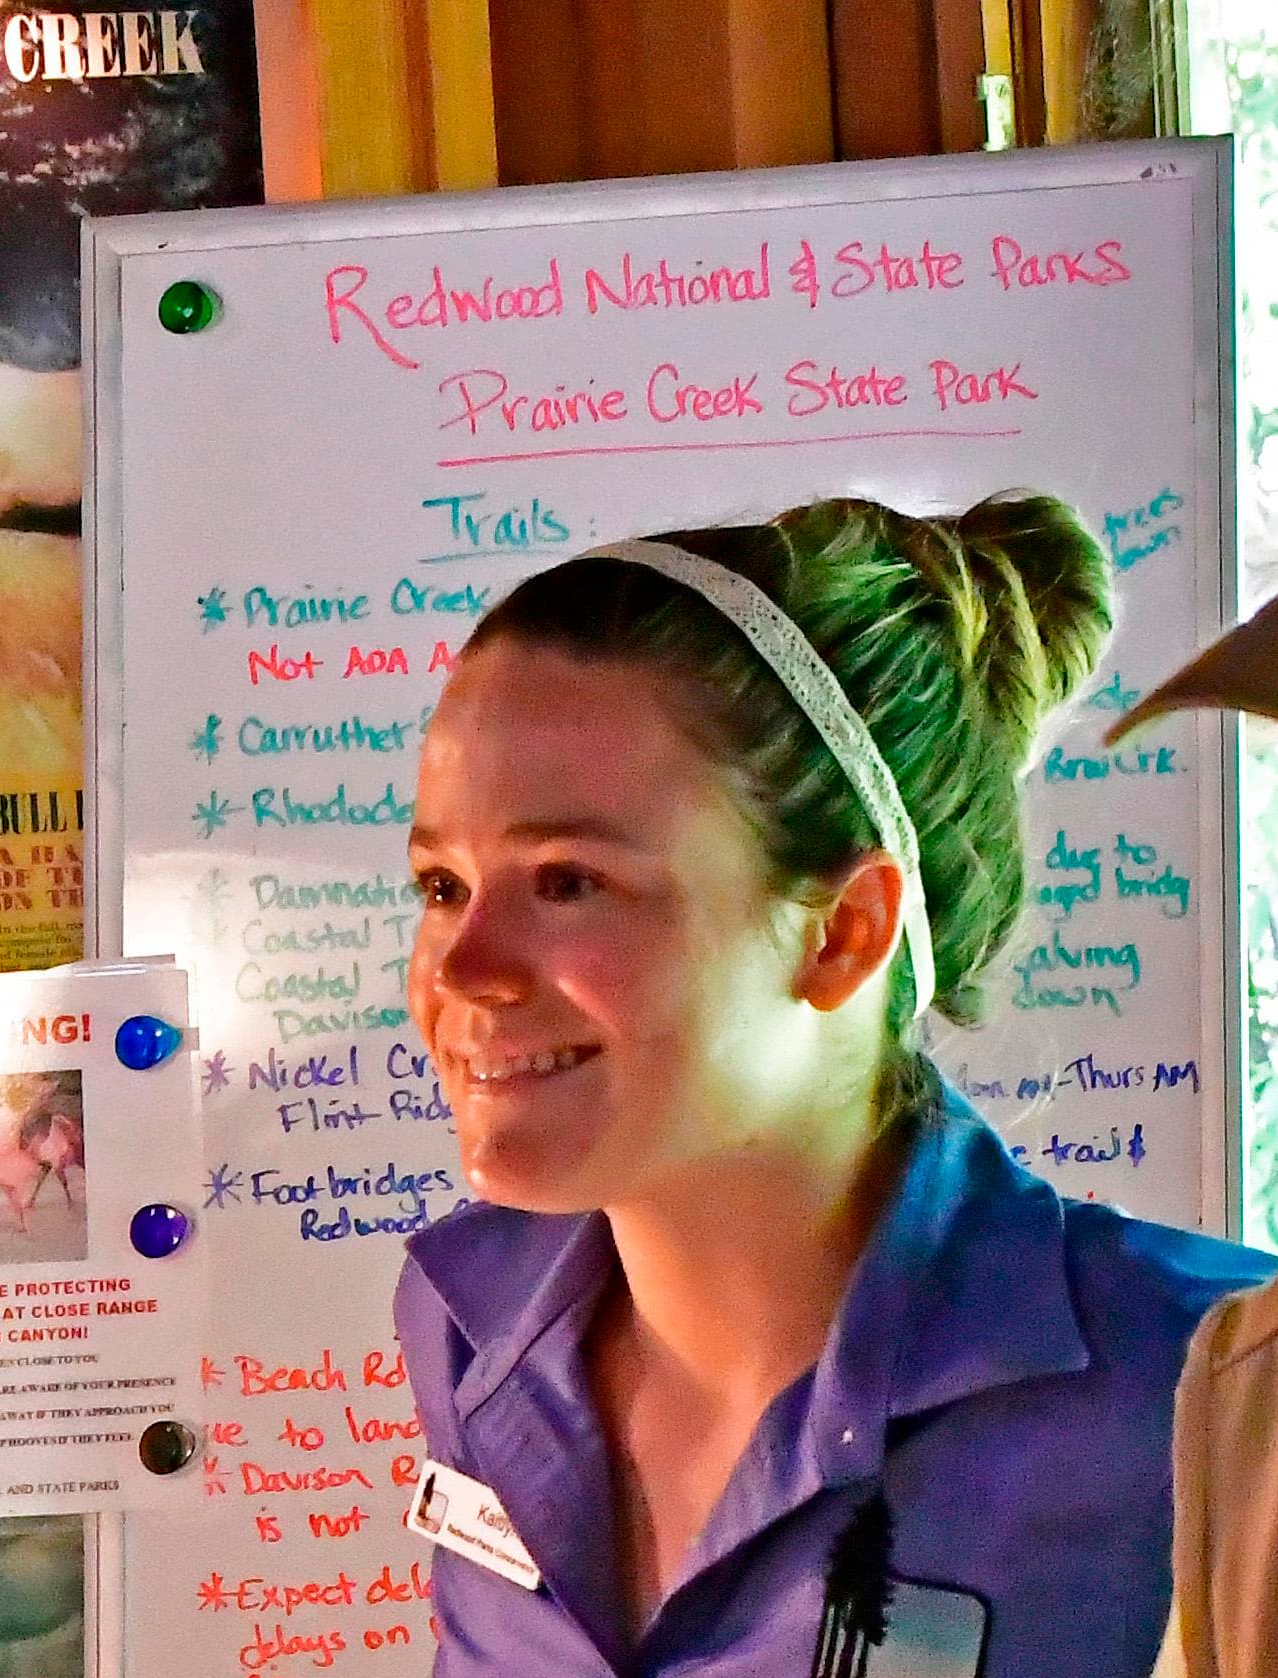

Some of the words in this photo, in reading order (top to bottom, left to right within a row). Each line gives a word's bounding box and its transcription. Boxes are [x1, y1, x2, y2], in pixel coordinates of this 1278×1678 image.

[4, 10, 207, 82] CREEK
[325, 257, 563, 370] Redwood
[584, 241, 770, 315] National
[831, 240, 964, 298] State
[438, 368, 627, 435] Prairie
[647, 362, 763, 424] Creek
[784, 358, 908, 417] State
[930, 358, 1039, 412] Park
[243, 584, 372, 628] Prairie
[248, 644, 324, 686] Not
[249, 1046, 359, 1092] Nickel
[14, 1278, 132, 1297] PROTECTING
[2, 1306, 26, 1321] AT
[31, 1302, 90, 1319] CLOSE
[96, 1298, 158, 1315] RANGE
[7, 1326, 89, 1344] CANYON!
[234, 1349, 347, 1397] Beach
[278, 1415, 325, 1452] to
[6, 1483, 34, 1495] AND
[37, 1481, 76, 1494] STATE
[79, 1479, 120, 1492] PARKS
[255, 1506, 283, 1543] is
[309, 1505, 370, 1538] not
[236, 1572, 357, 1617] Expect
[363, 1625, 410, 1651] on
